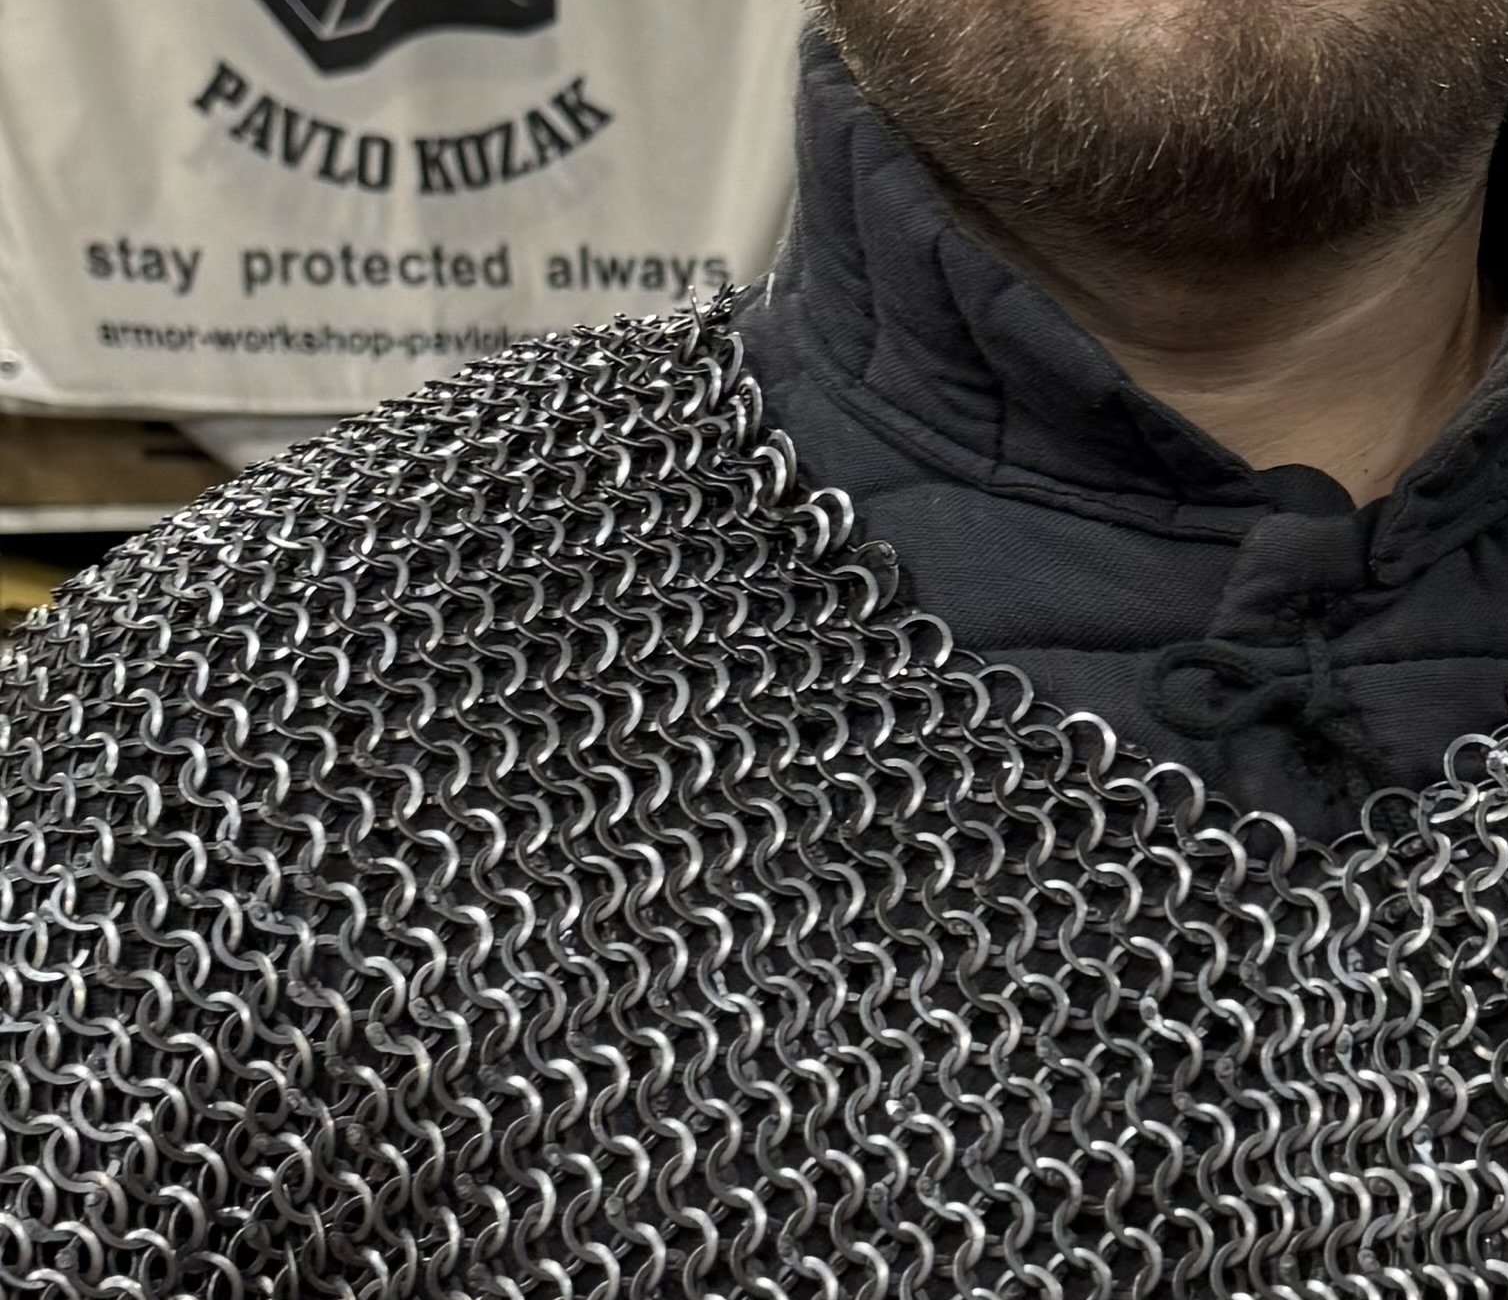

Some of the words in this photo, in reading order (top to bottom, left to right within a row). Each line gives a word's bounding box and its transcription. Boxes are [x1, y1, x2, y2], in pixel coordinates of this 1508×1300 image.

[191, 61, 396, 193] PAVLO
[84, 238, 201, 294] stay
[241, 240, 512, 294] protected
[547, 244, 731, 300] always
